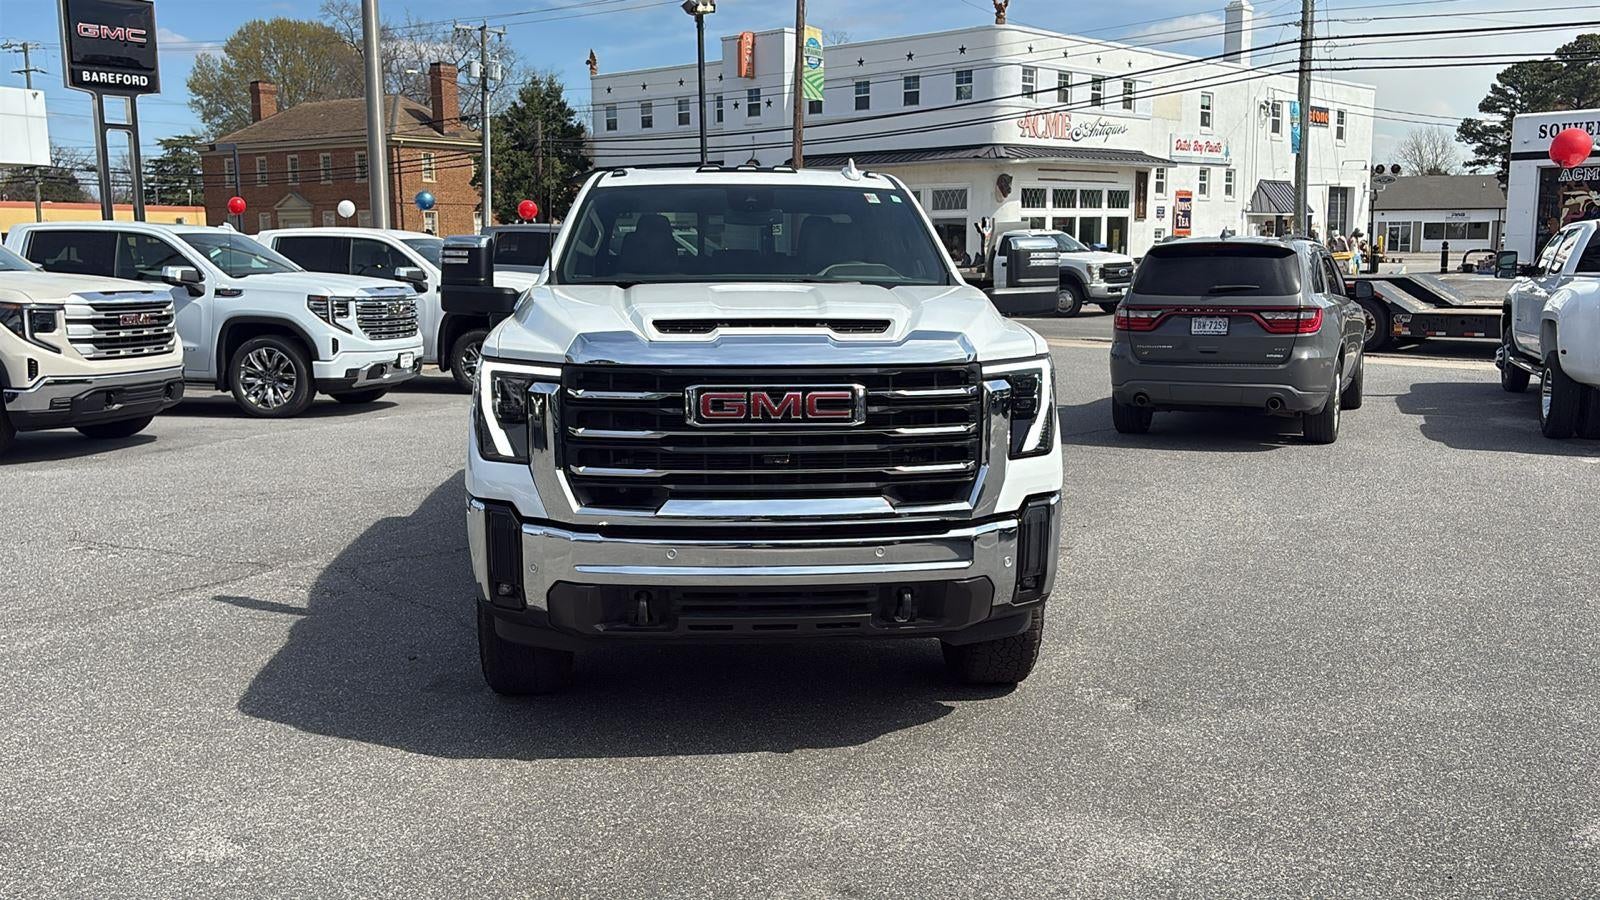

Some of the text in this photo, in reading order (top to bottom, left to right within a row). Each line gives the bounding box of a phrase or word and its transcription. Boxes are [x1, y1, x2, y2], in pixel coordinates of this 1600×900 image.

[77, 22, 147, 43] GMC
[82, 70, 149, 87] BAREFORD
[1017, 111, 1072, 140] ACME
[1178, 215, 1190, 227] TEA
[700, 391, 852, 419] GMC
